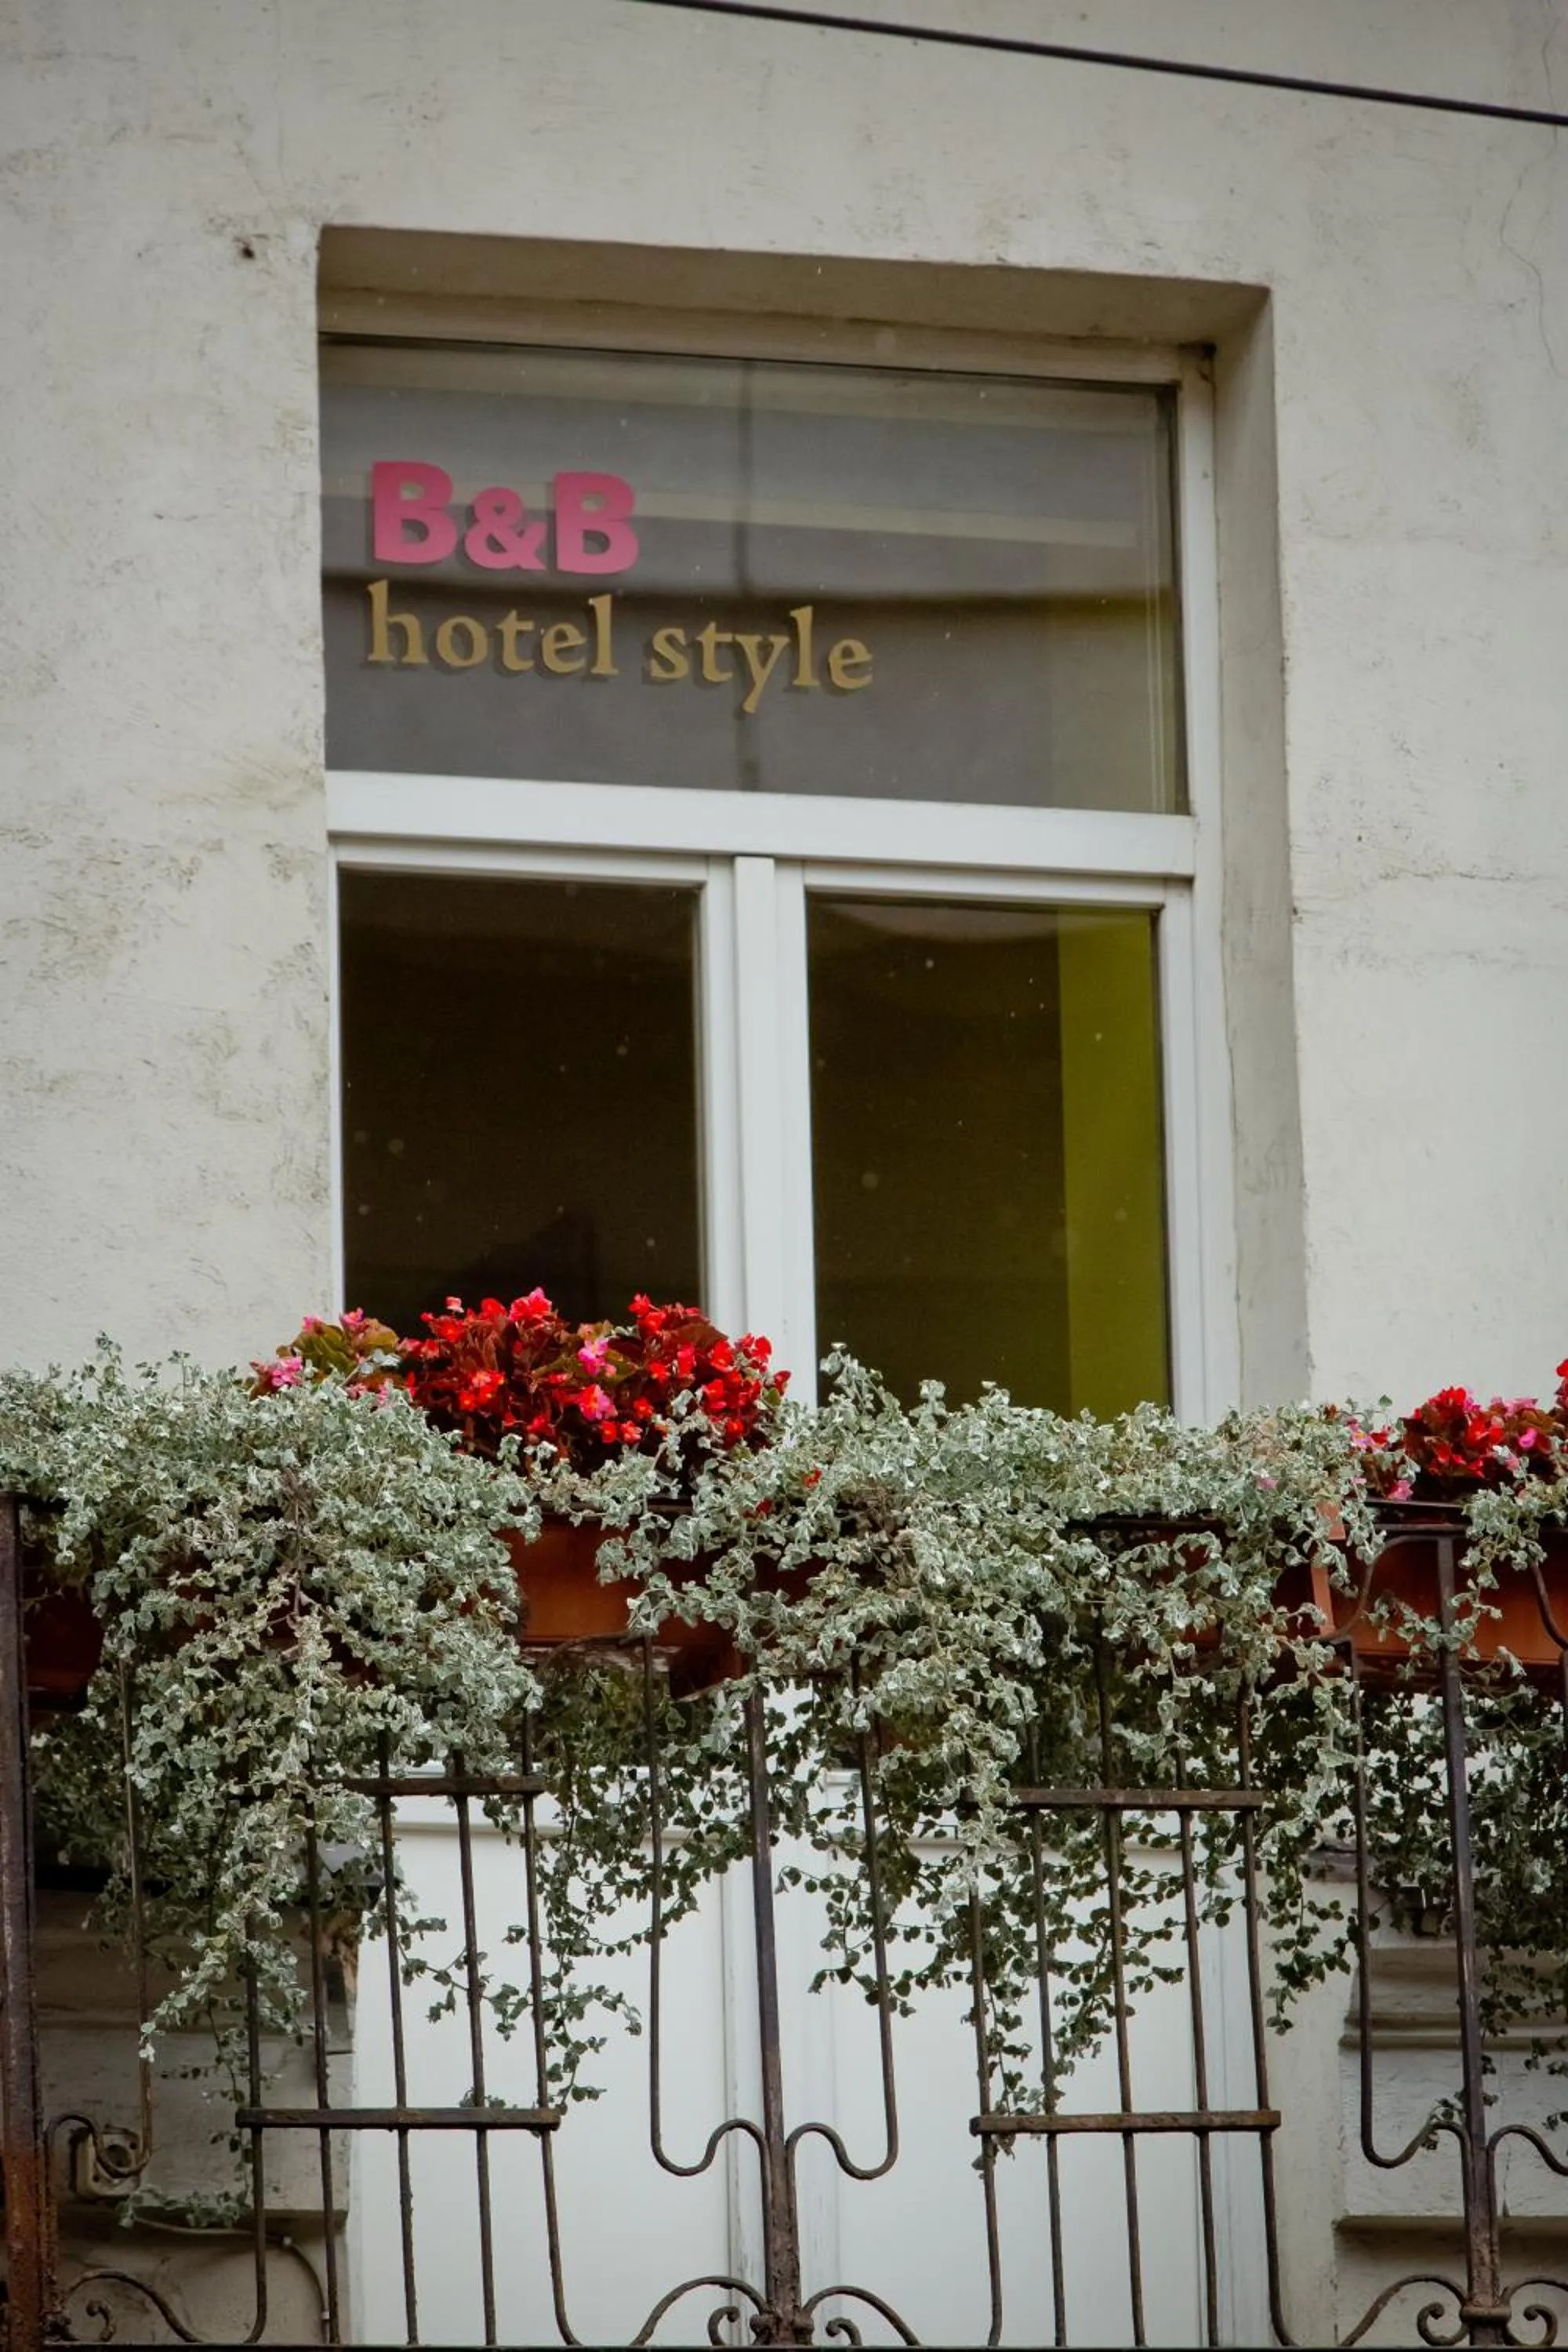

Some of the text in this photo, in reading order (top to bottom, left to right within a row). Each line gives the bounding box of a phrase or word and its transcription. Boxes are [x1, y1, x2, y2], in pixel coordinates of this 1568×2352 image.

[372, 460, 639, 574] B&B
[367, 579, 873, 713] hotel style
